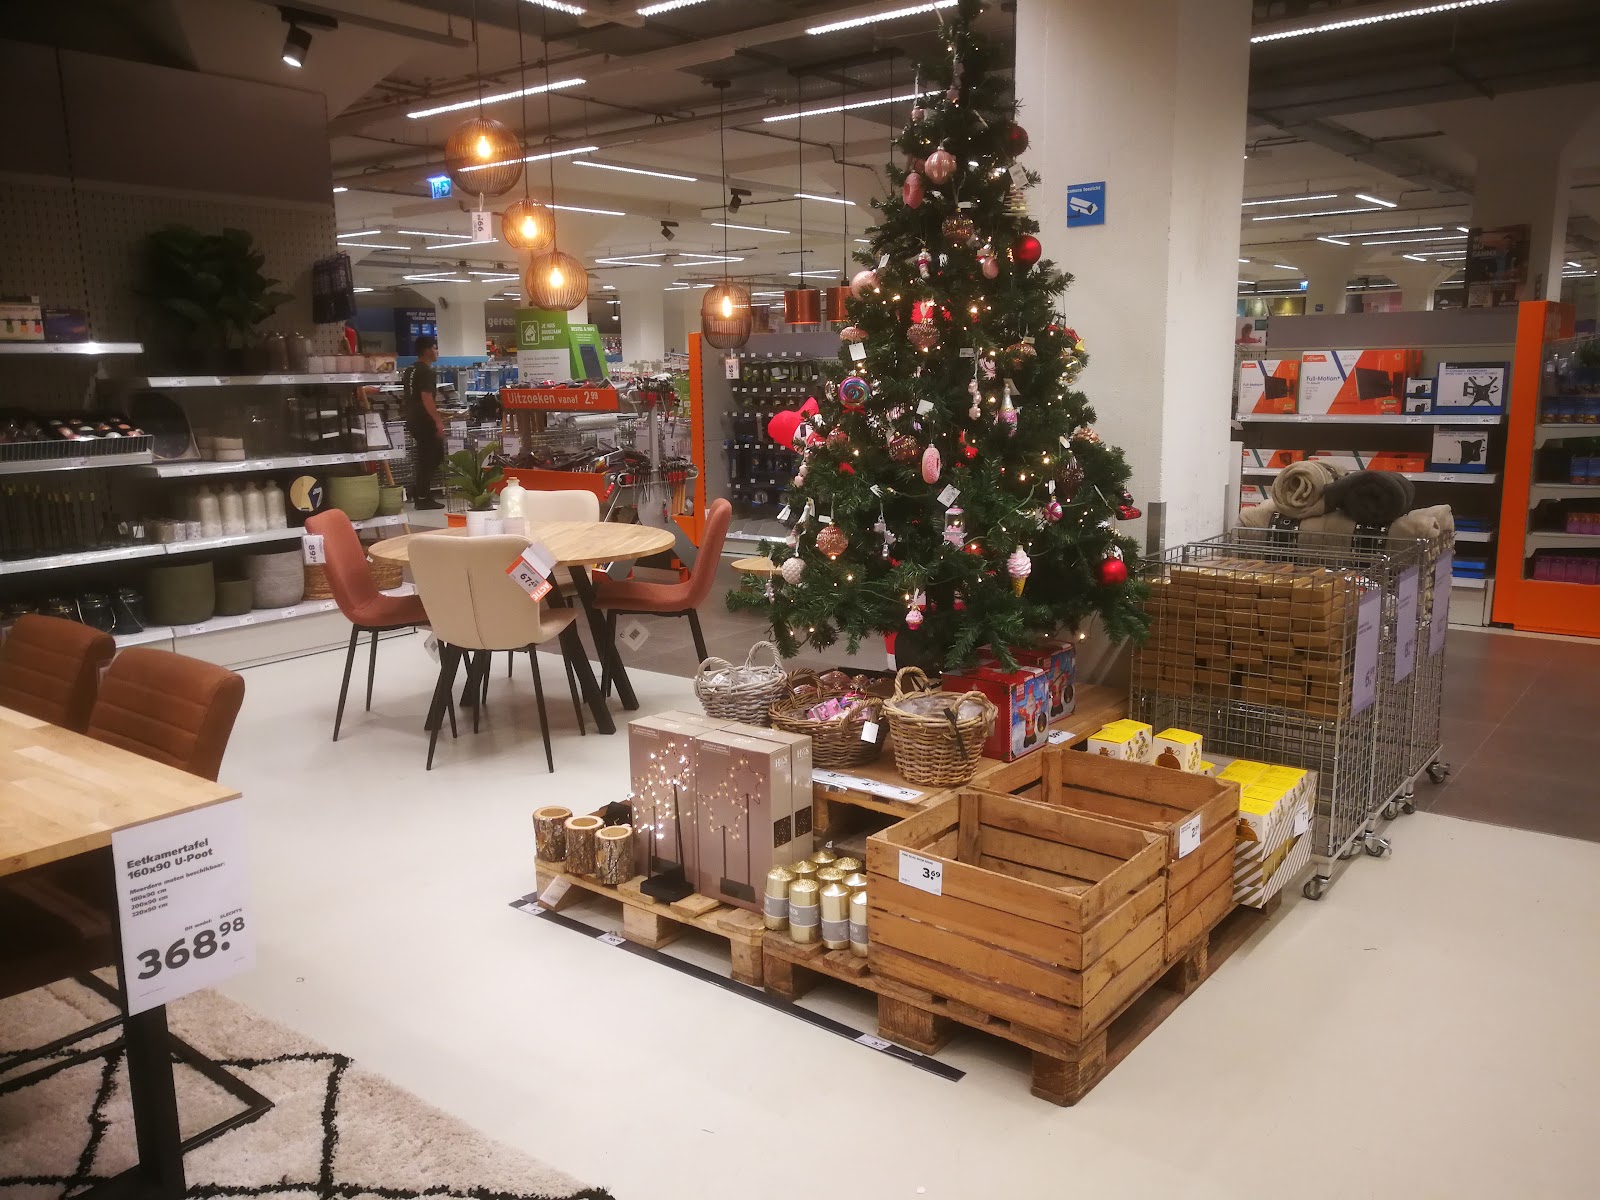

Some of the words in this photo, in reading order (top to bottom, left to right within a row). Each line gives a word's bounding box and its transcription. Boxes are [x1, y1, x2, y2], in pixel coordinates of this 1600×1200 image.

[507, 391, 556, 405] Uitzoeken
[558, 394, 579, 405] vanaf
[531, 582, 551, 601] ACTIE
[127, 838, 209, 869] Eetkamertafel
[127, 860, 171, 880] 160x90
[174, 847, 213, 867] U-Poot
[164, 875, 185, 885] maten
[922, 867, 941, 881] 3.69
[157, 887, 167, 895] cm
[158, 894, 169, 902] cm
[158, 901, 169, 909] cm
